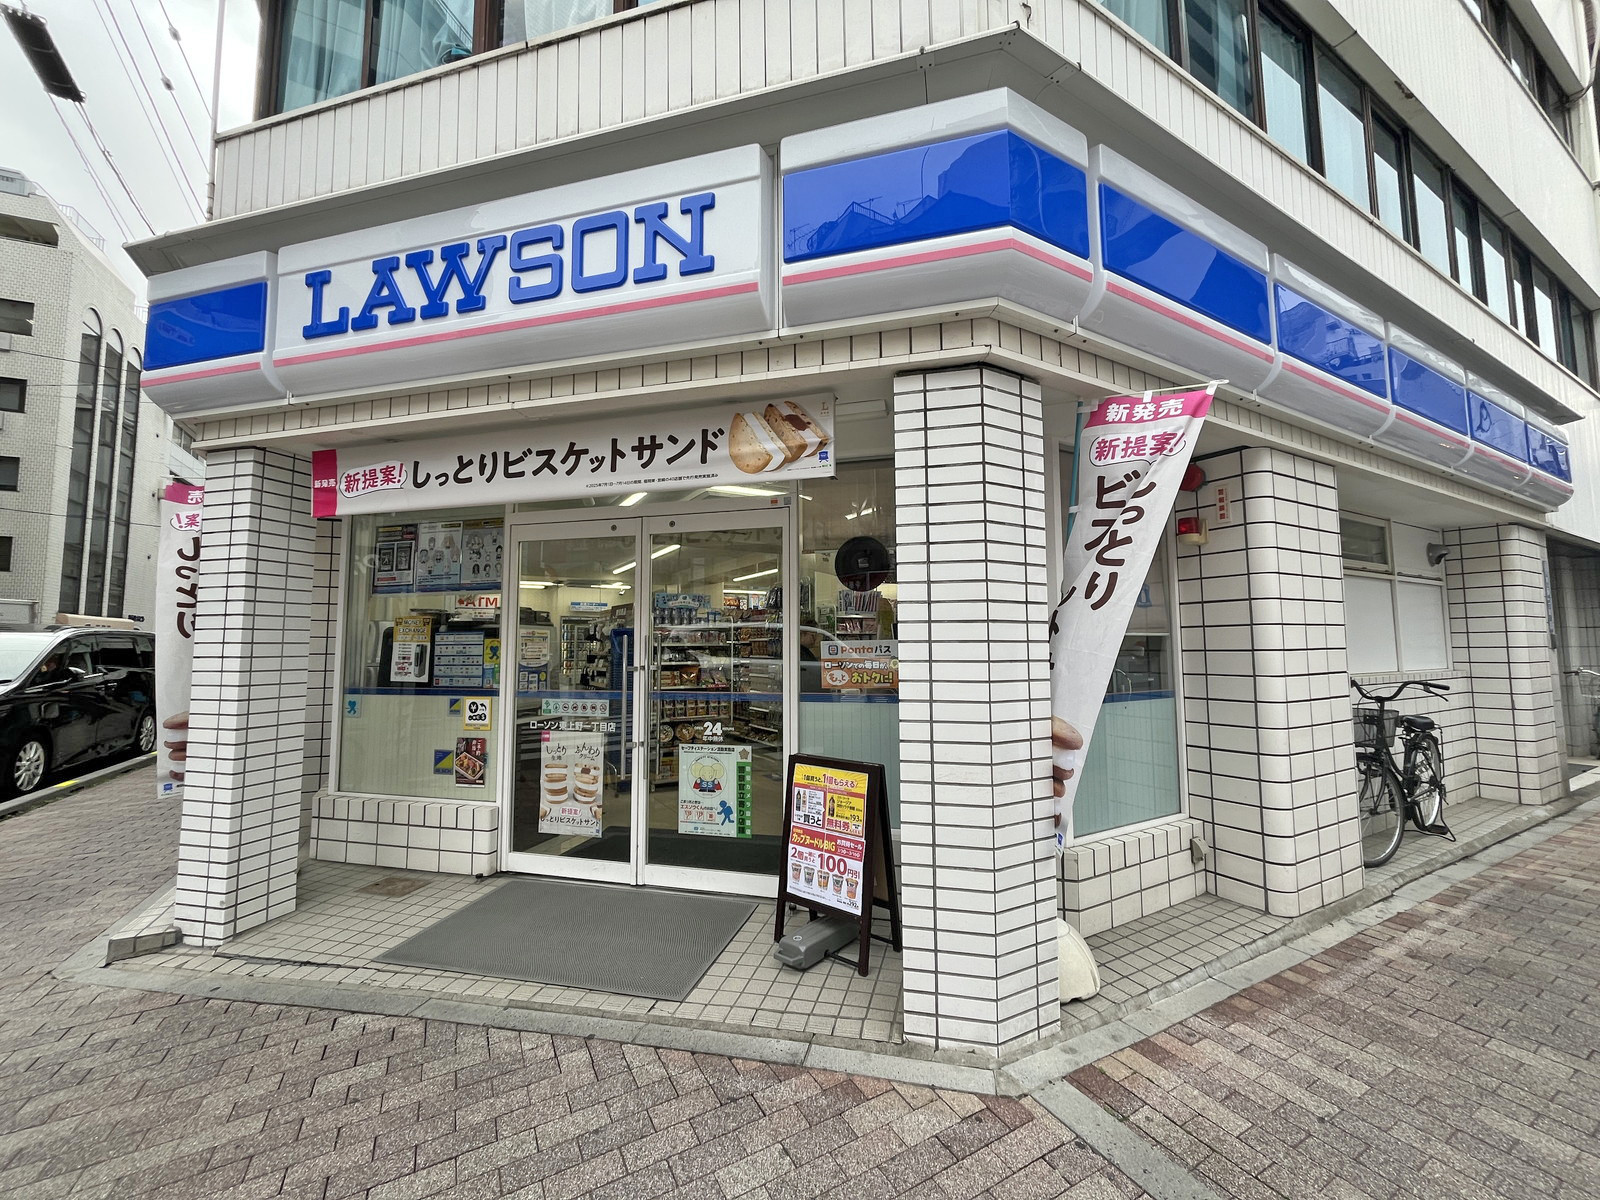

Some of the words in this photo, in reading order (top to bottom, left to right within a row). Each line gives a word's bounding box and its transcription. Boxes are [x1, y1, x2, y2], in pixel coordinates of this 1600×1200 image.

[302, 191, 716, 340] LAWSON
[1105, 398, 1185, 422] 新発売
[412, 427, 725, 489] しっとりビスケットサンド
[313, 478, 337, 488] 新発売
[344, 462, 404, 493] 新提案!
[464, 596, 498, 608] ATM
[841, 645, 892, 654] Pontaパス
[851, 671, 893, 685] おトクに!
[529, 720, 616, 732] ローソン東上野一丁目店
[703, 721, 723, 736] 24
[546, 743, 567, 756] しっとり
[575, 742, 600, 757] ふんわり
[803, 814, 822, 826] 買うと
[826, 818, 850, 832] 無料券
[791, 832, 836, 852] カップヌードルBIG
